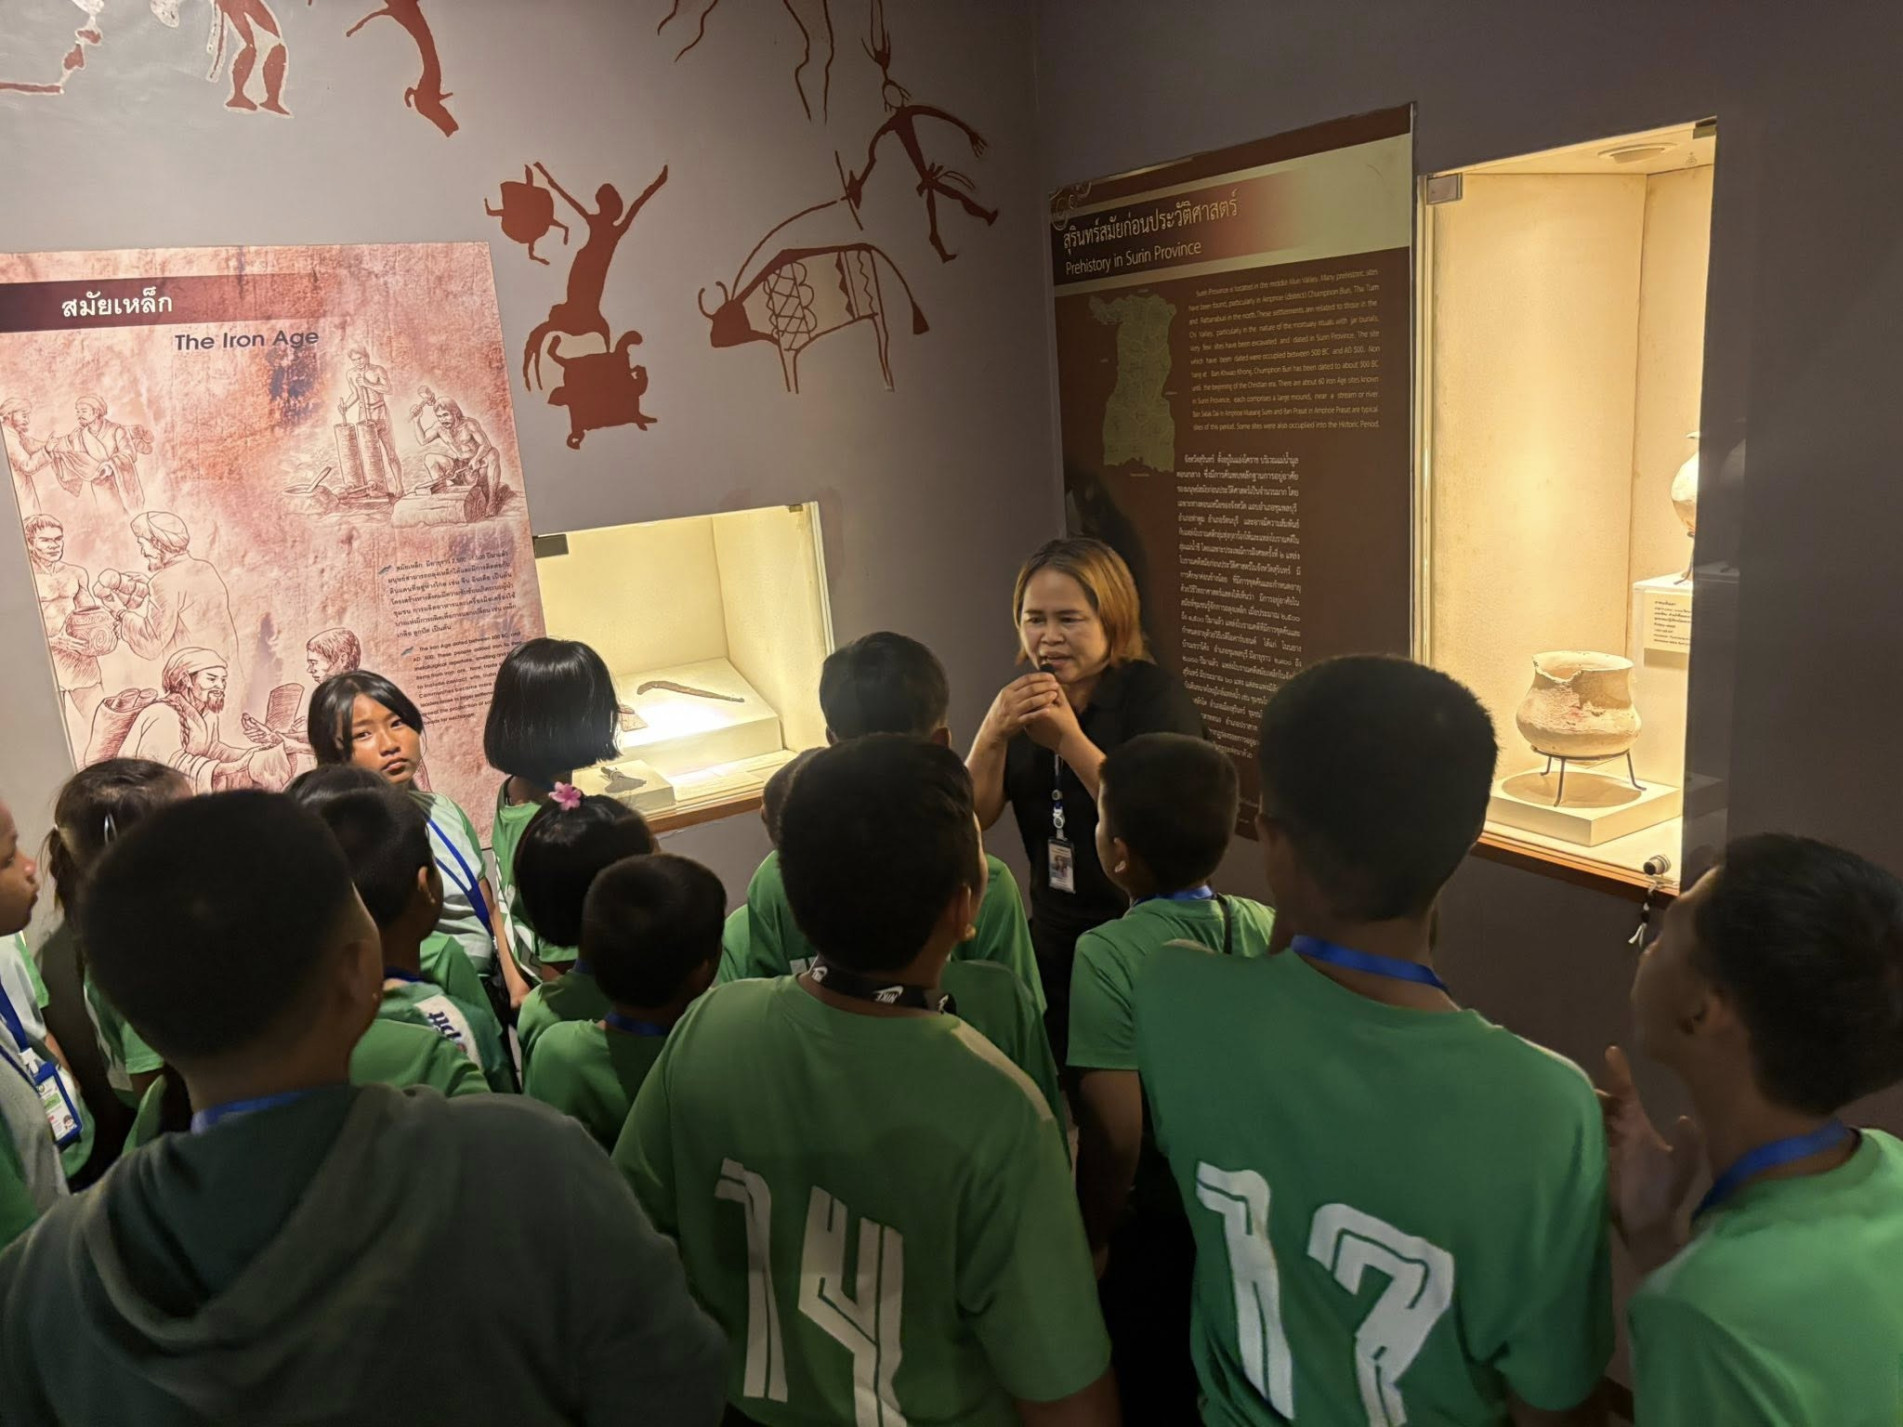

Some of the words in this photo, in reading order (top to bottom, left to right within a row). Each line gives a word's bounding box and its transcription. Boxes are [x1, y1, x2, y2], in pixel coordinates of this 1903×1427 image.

[1063, 188, 1238, 255] สุรินทร์สมัยก่อนประวัติศาสตร์
[1065, 256, 1111, 277] Prehistory
[1113, 252, 1124, 268] in
[1126, 247, 1151, 267] Surin
[1154, 241, 1202, 264] Province
[61, 287, 173, 317] สมัยเหล็ก
[175, 333, 215, 351] The
[223, 331, 265, 348] Iron
[272, 329, 320, 348] Age
[714, 1157, 907, 1427] 14
[1195, 1160, 1455, 1427] 17
